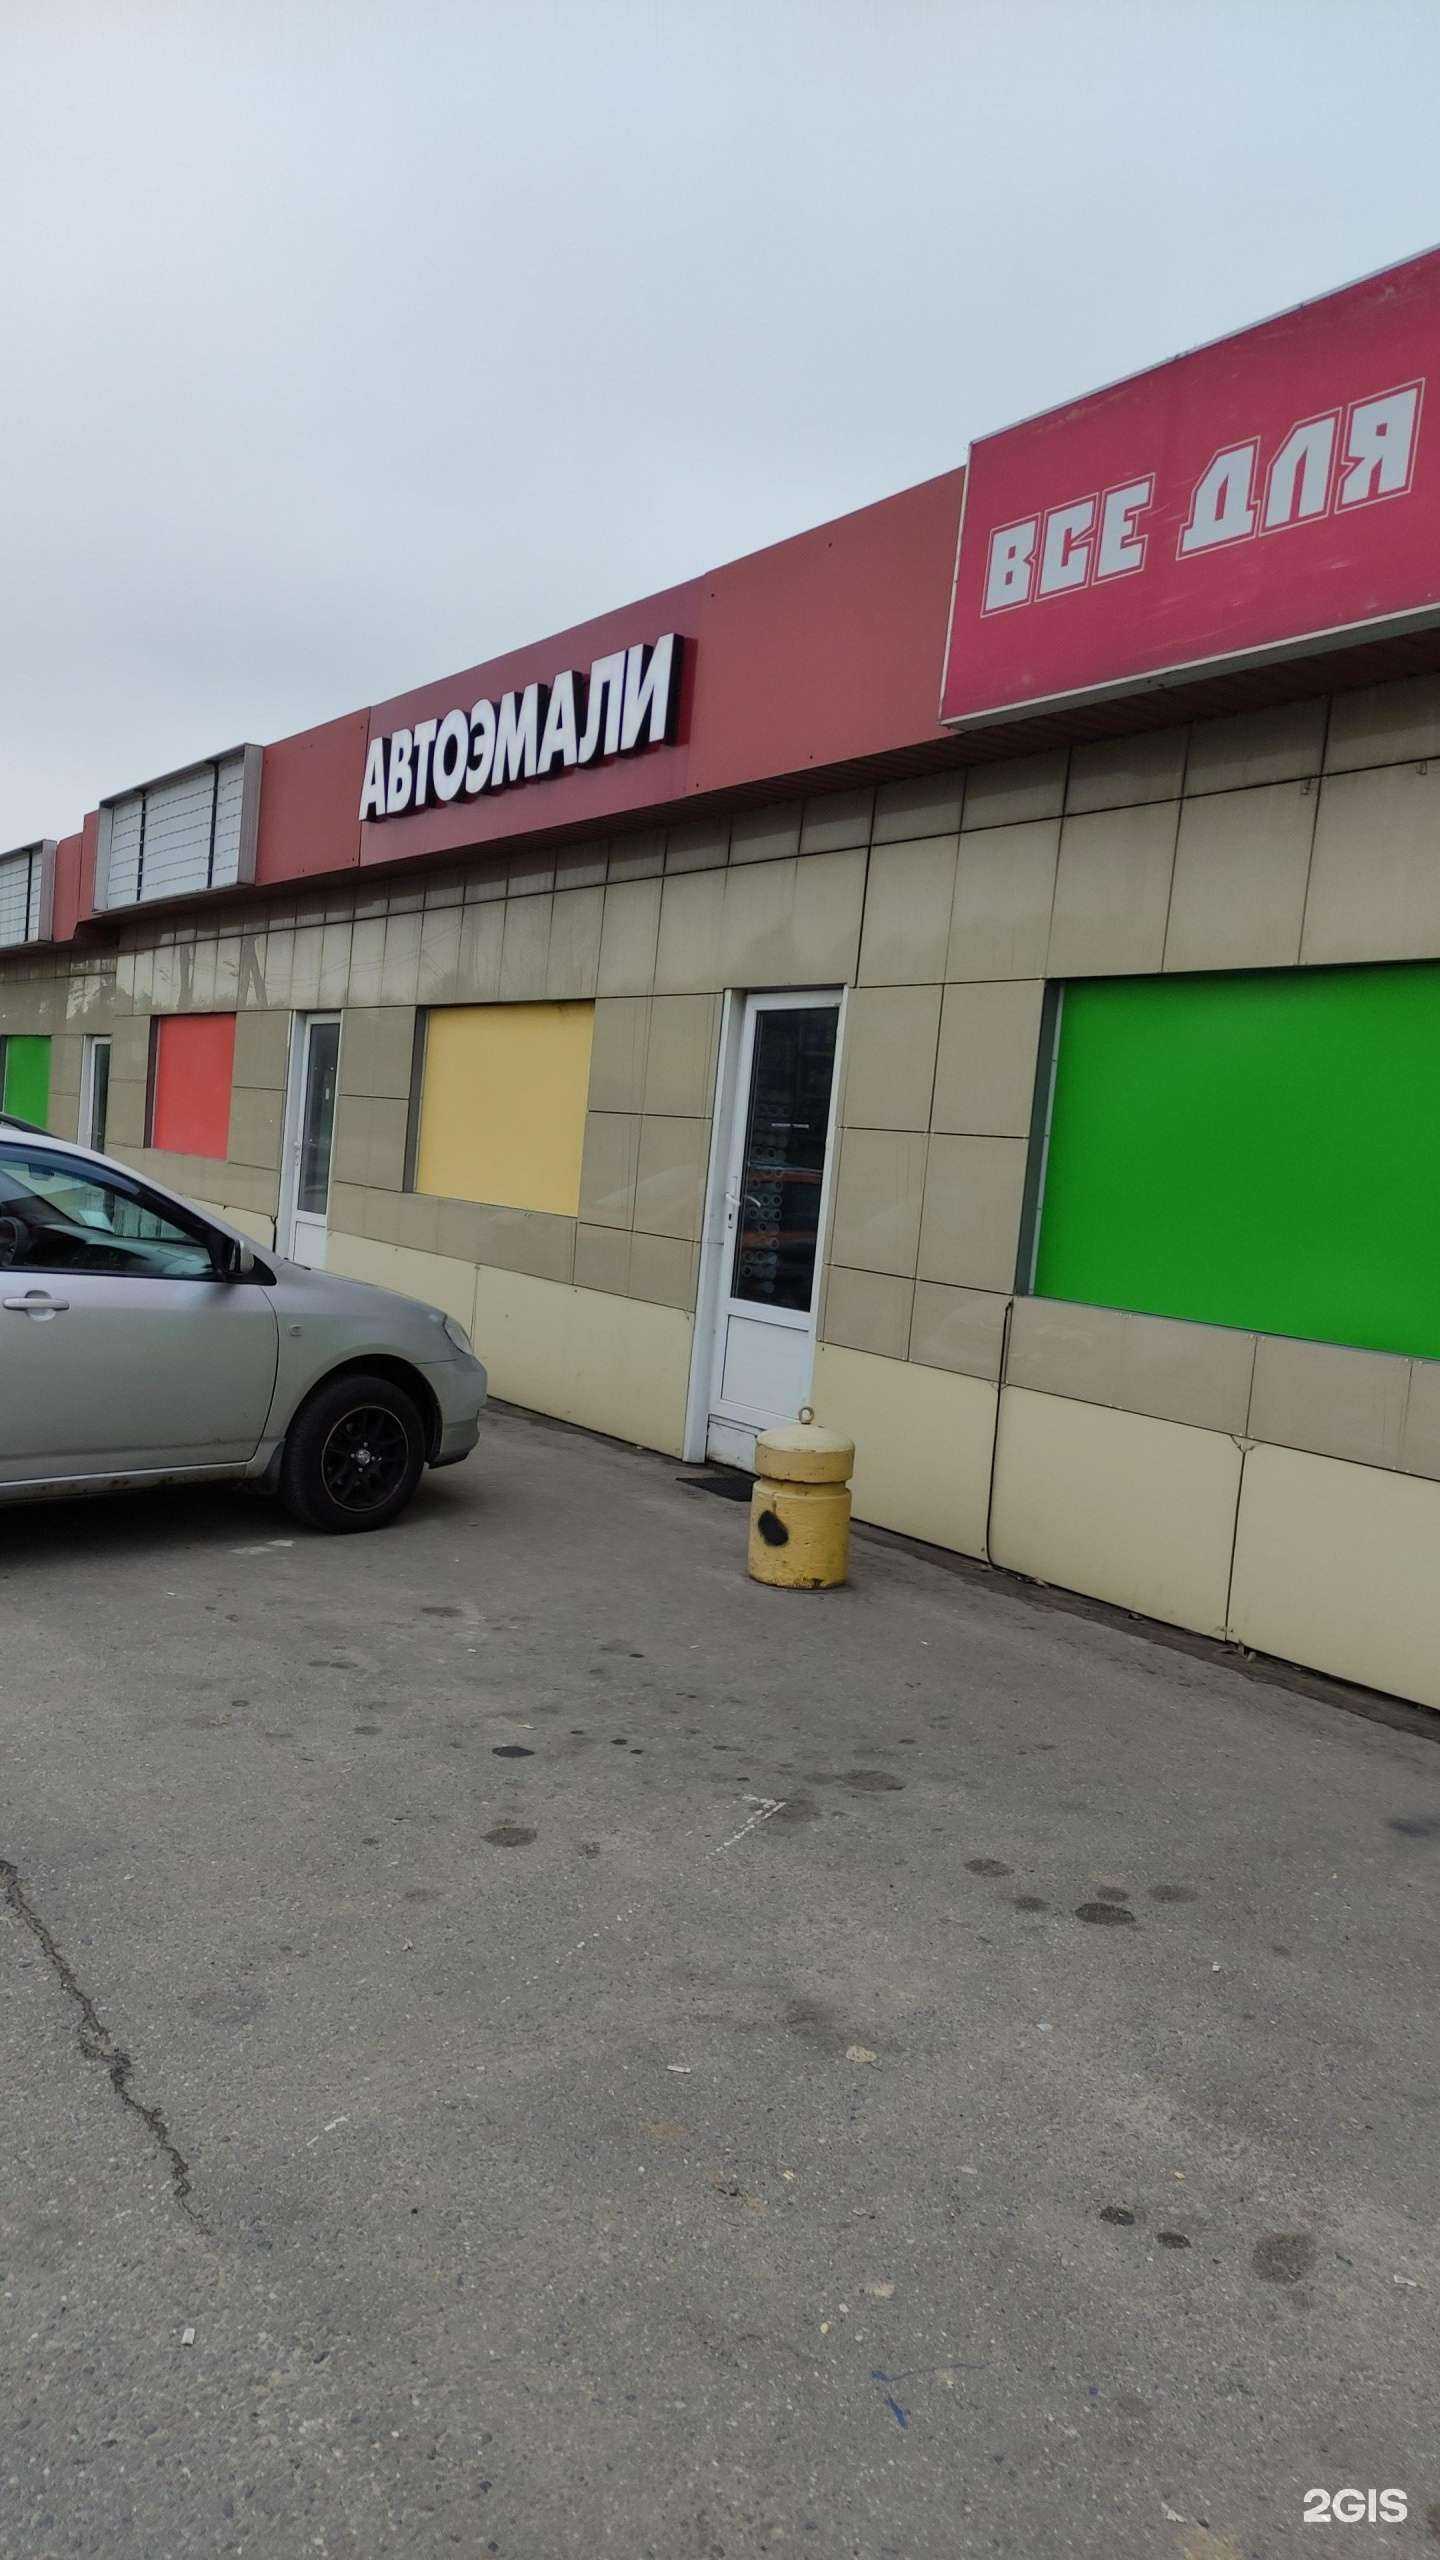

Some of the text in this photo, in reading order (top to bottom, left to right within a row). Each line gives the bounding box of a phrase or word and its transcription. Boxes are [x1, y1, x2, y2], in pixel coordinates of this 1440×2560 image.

[981, 378, 1426, 617] ВСЕ ДЛЯ
[359, 633, 677, 821] АВТОЭМАЛИ
